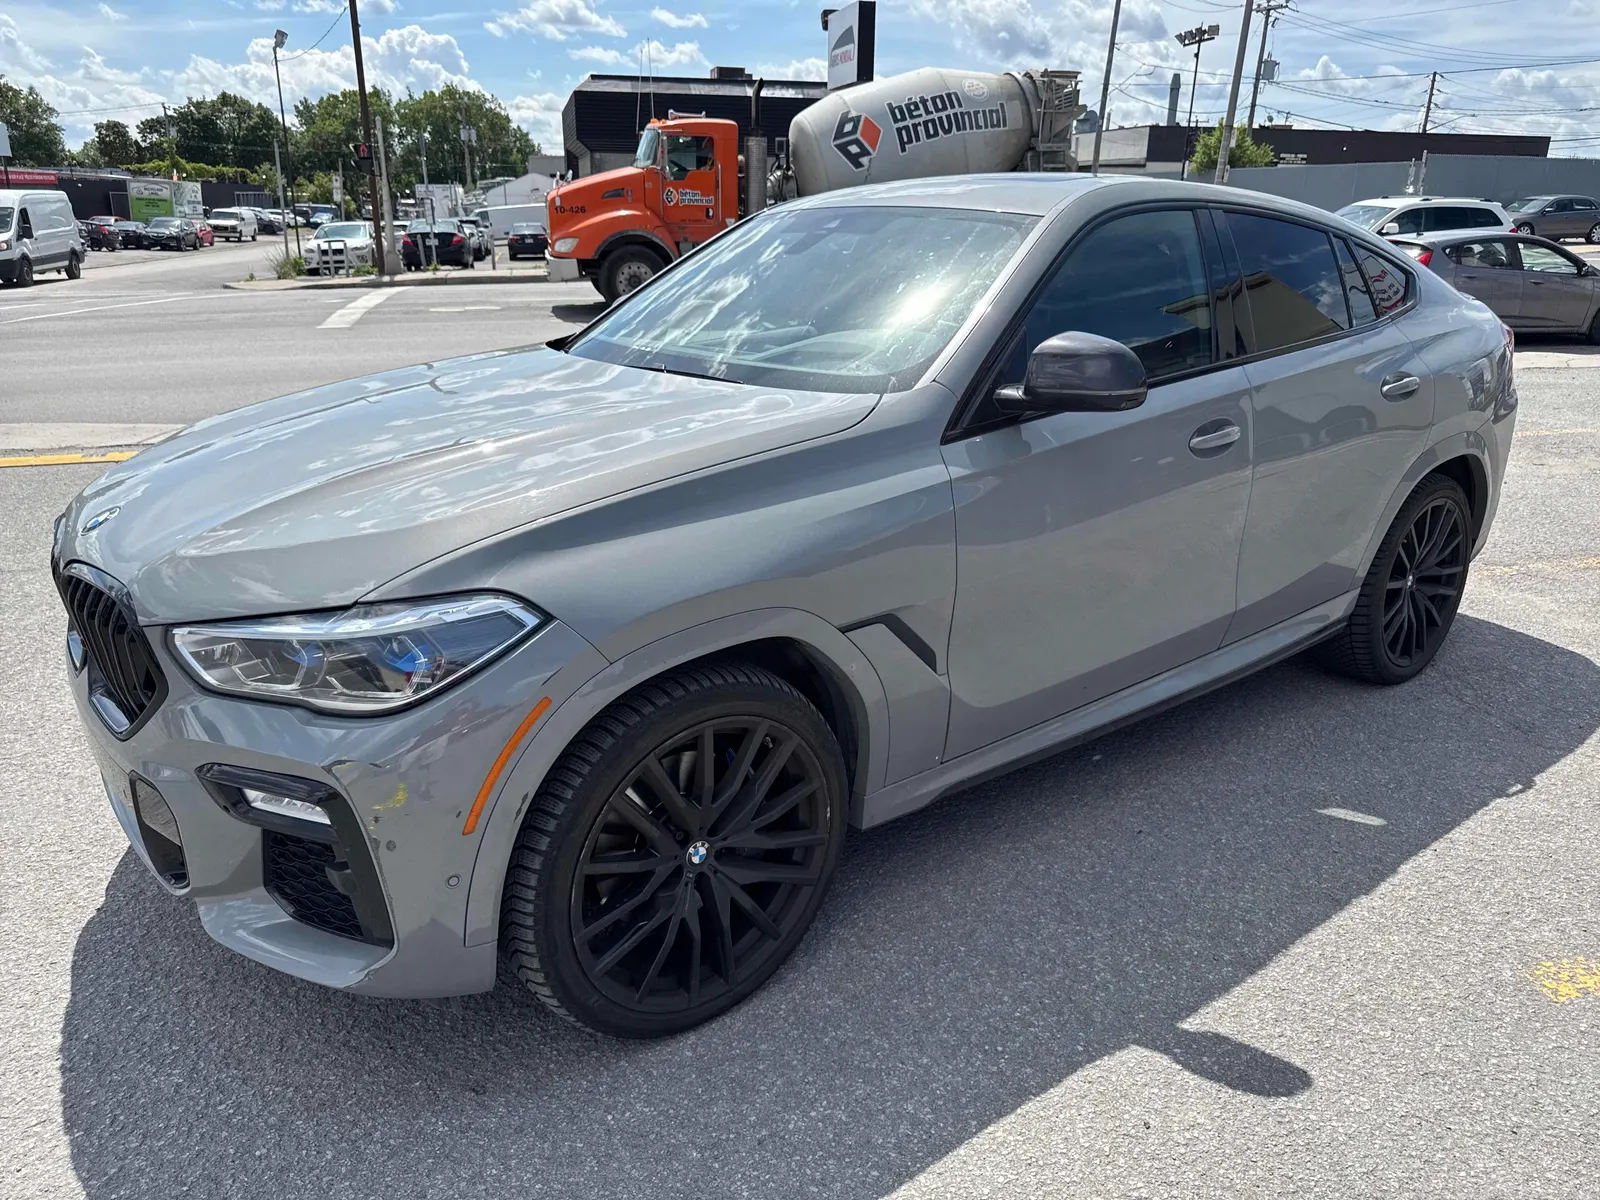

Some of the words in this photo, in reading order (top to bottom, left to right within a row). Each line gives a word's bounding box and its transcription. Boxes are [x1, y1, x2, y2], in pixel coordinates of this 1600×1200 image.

[886, 91, 963, 124] béton
[895, 103, 1008, 153] provincial
[679, 190, 700, 198] béton
[680, 197, 714, 205] provincial
[554, 206, 586, 214] 10-426
